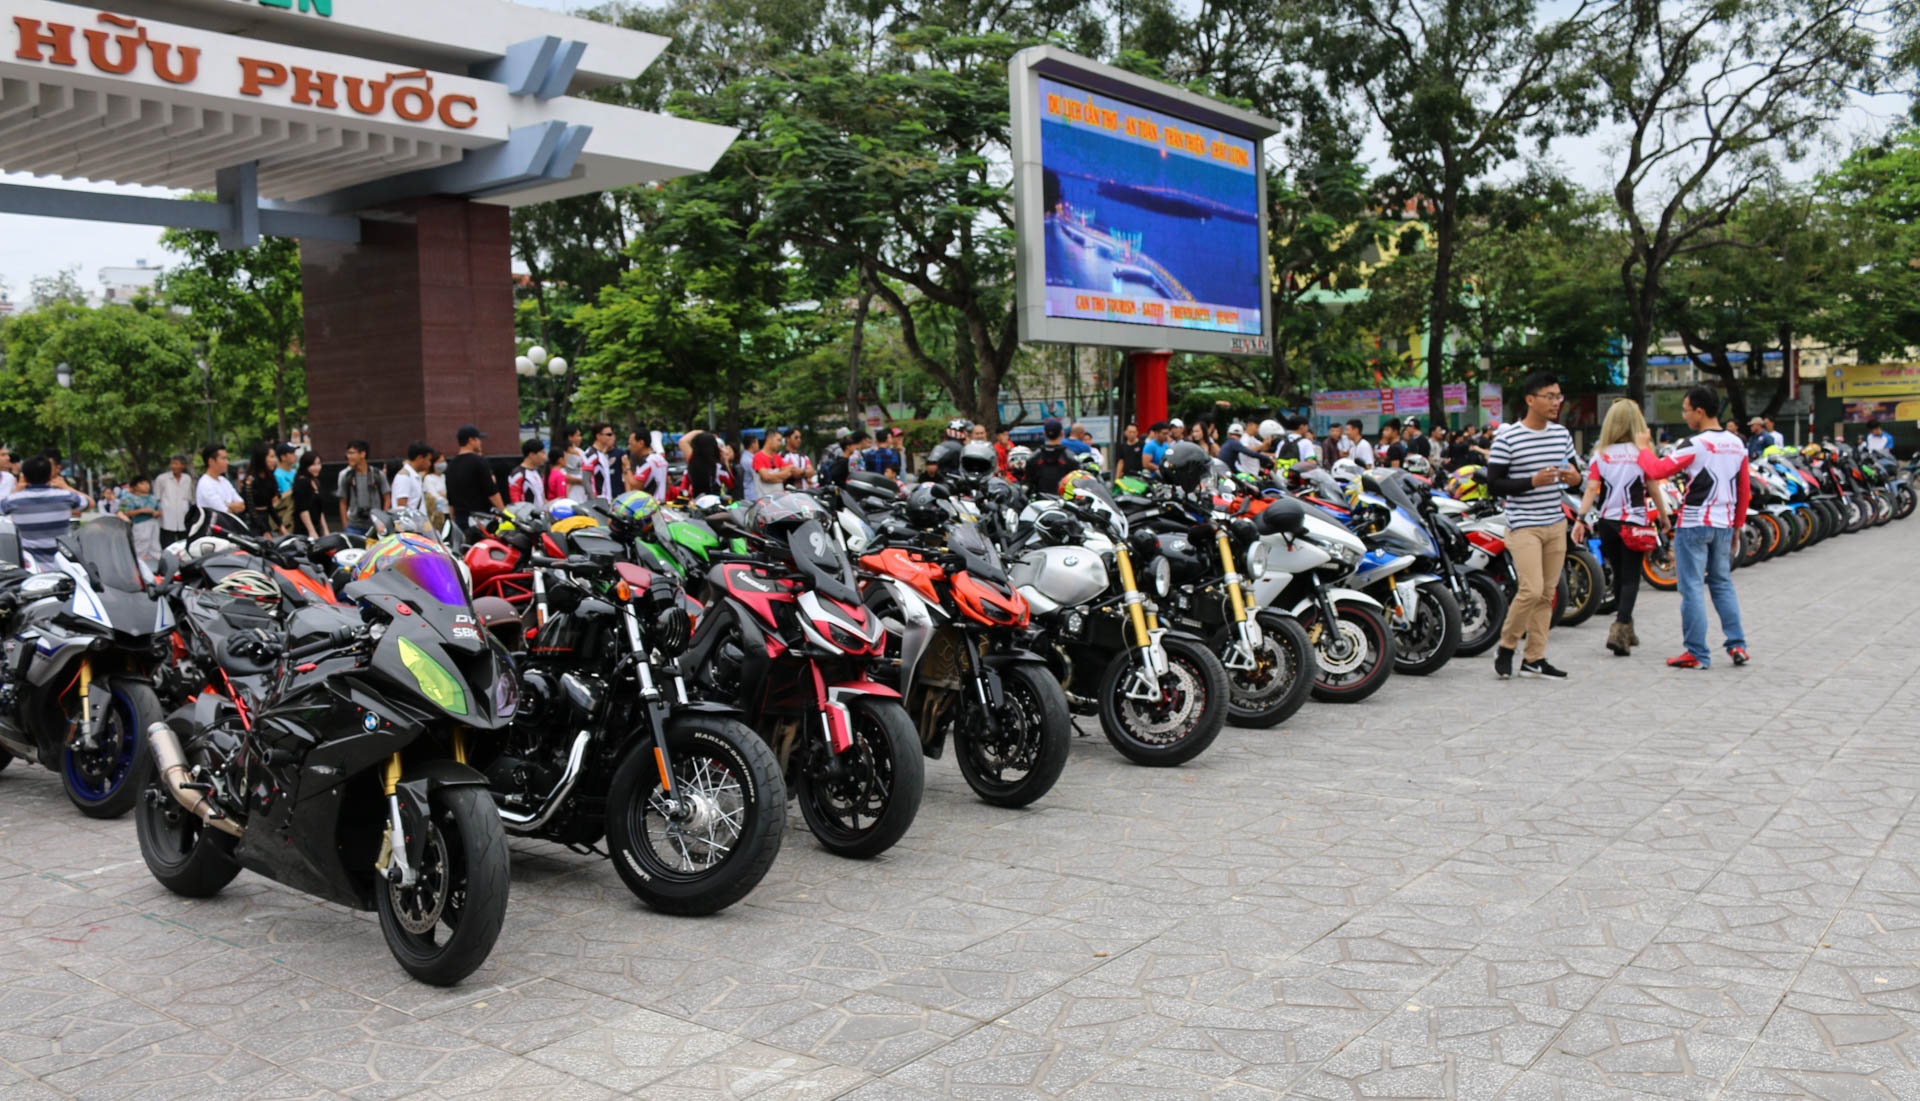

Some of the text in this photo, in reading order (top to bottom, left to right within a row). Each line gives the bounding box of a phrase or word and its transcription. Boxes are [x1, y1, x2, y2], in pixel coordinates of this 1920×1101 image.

[13, 12, 479, 129] HỮU PHƯỚC
[809, 531, 826, 557] 9
[737, 571, 770, 592] Kawasaki
